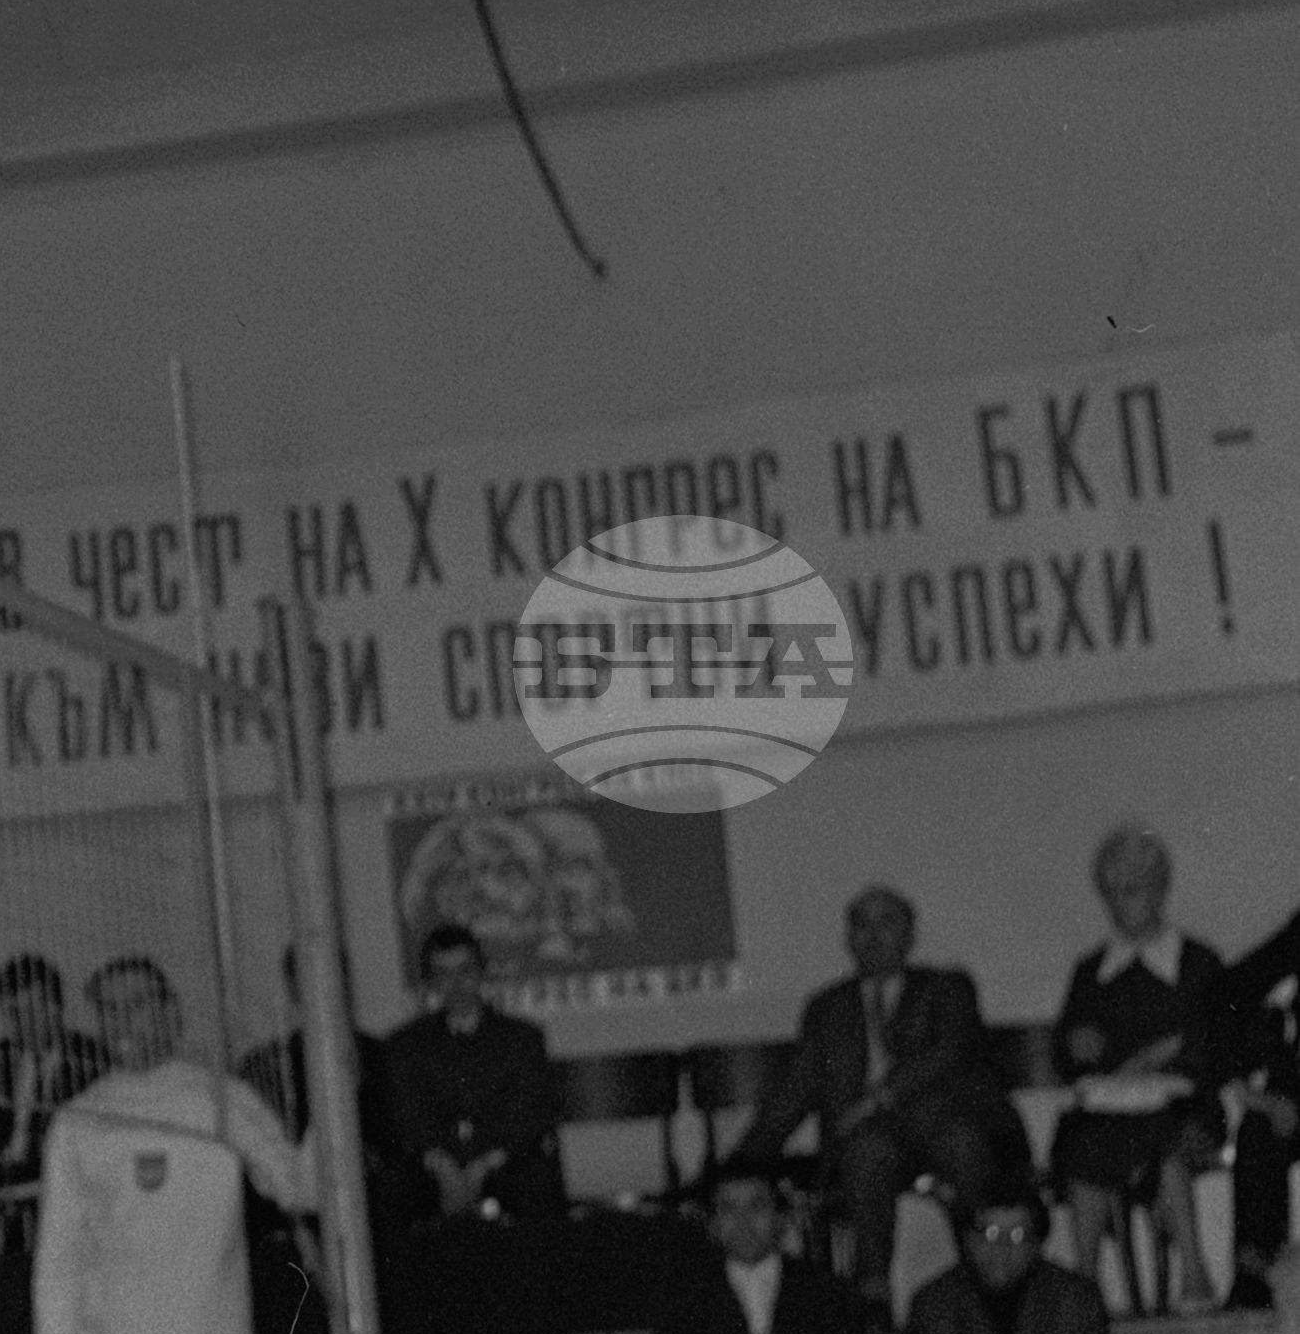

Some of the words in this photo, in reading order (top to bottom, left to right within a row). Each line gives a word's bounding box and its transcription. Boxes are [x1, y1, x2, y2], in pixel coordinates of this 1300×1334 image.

[286, 499, 375, 597] НА
[832, 429, 923, 538] НА
[977, 381, 1173, 520] БКП
[4, 661, 159, 767] КЪМ
